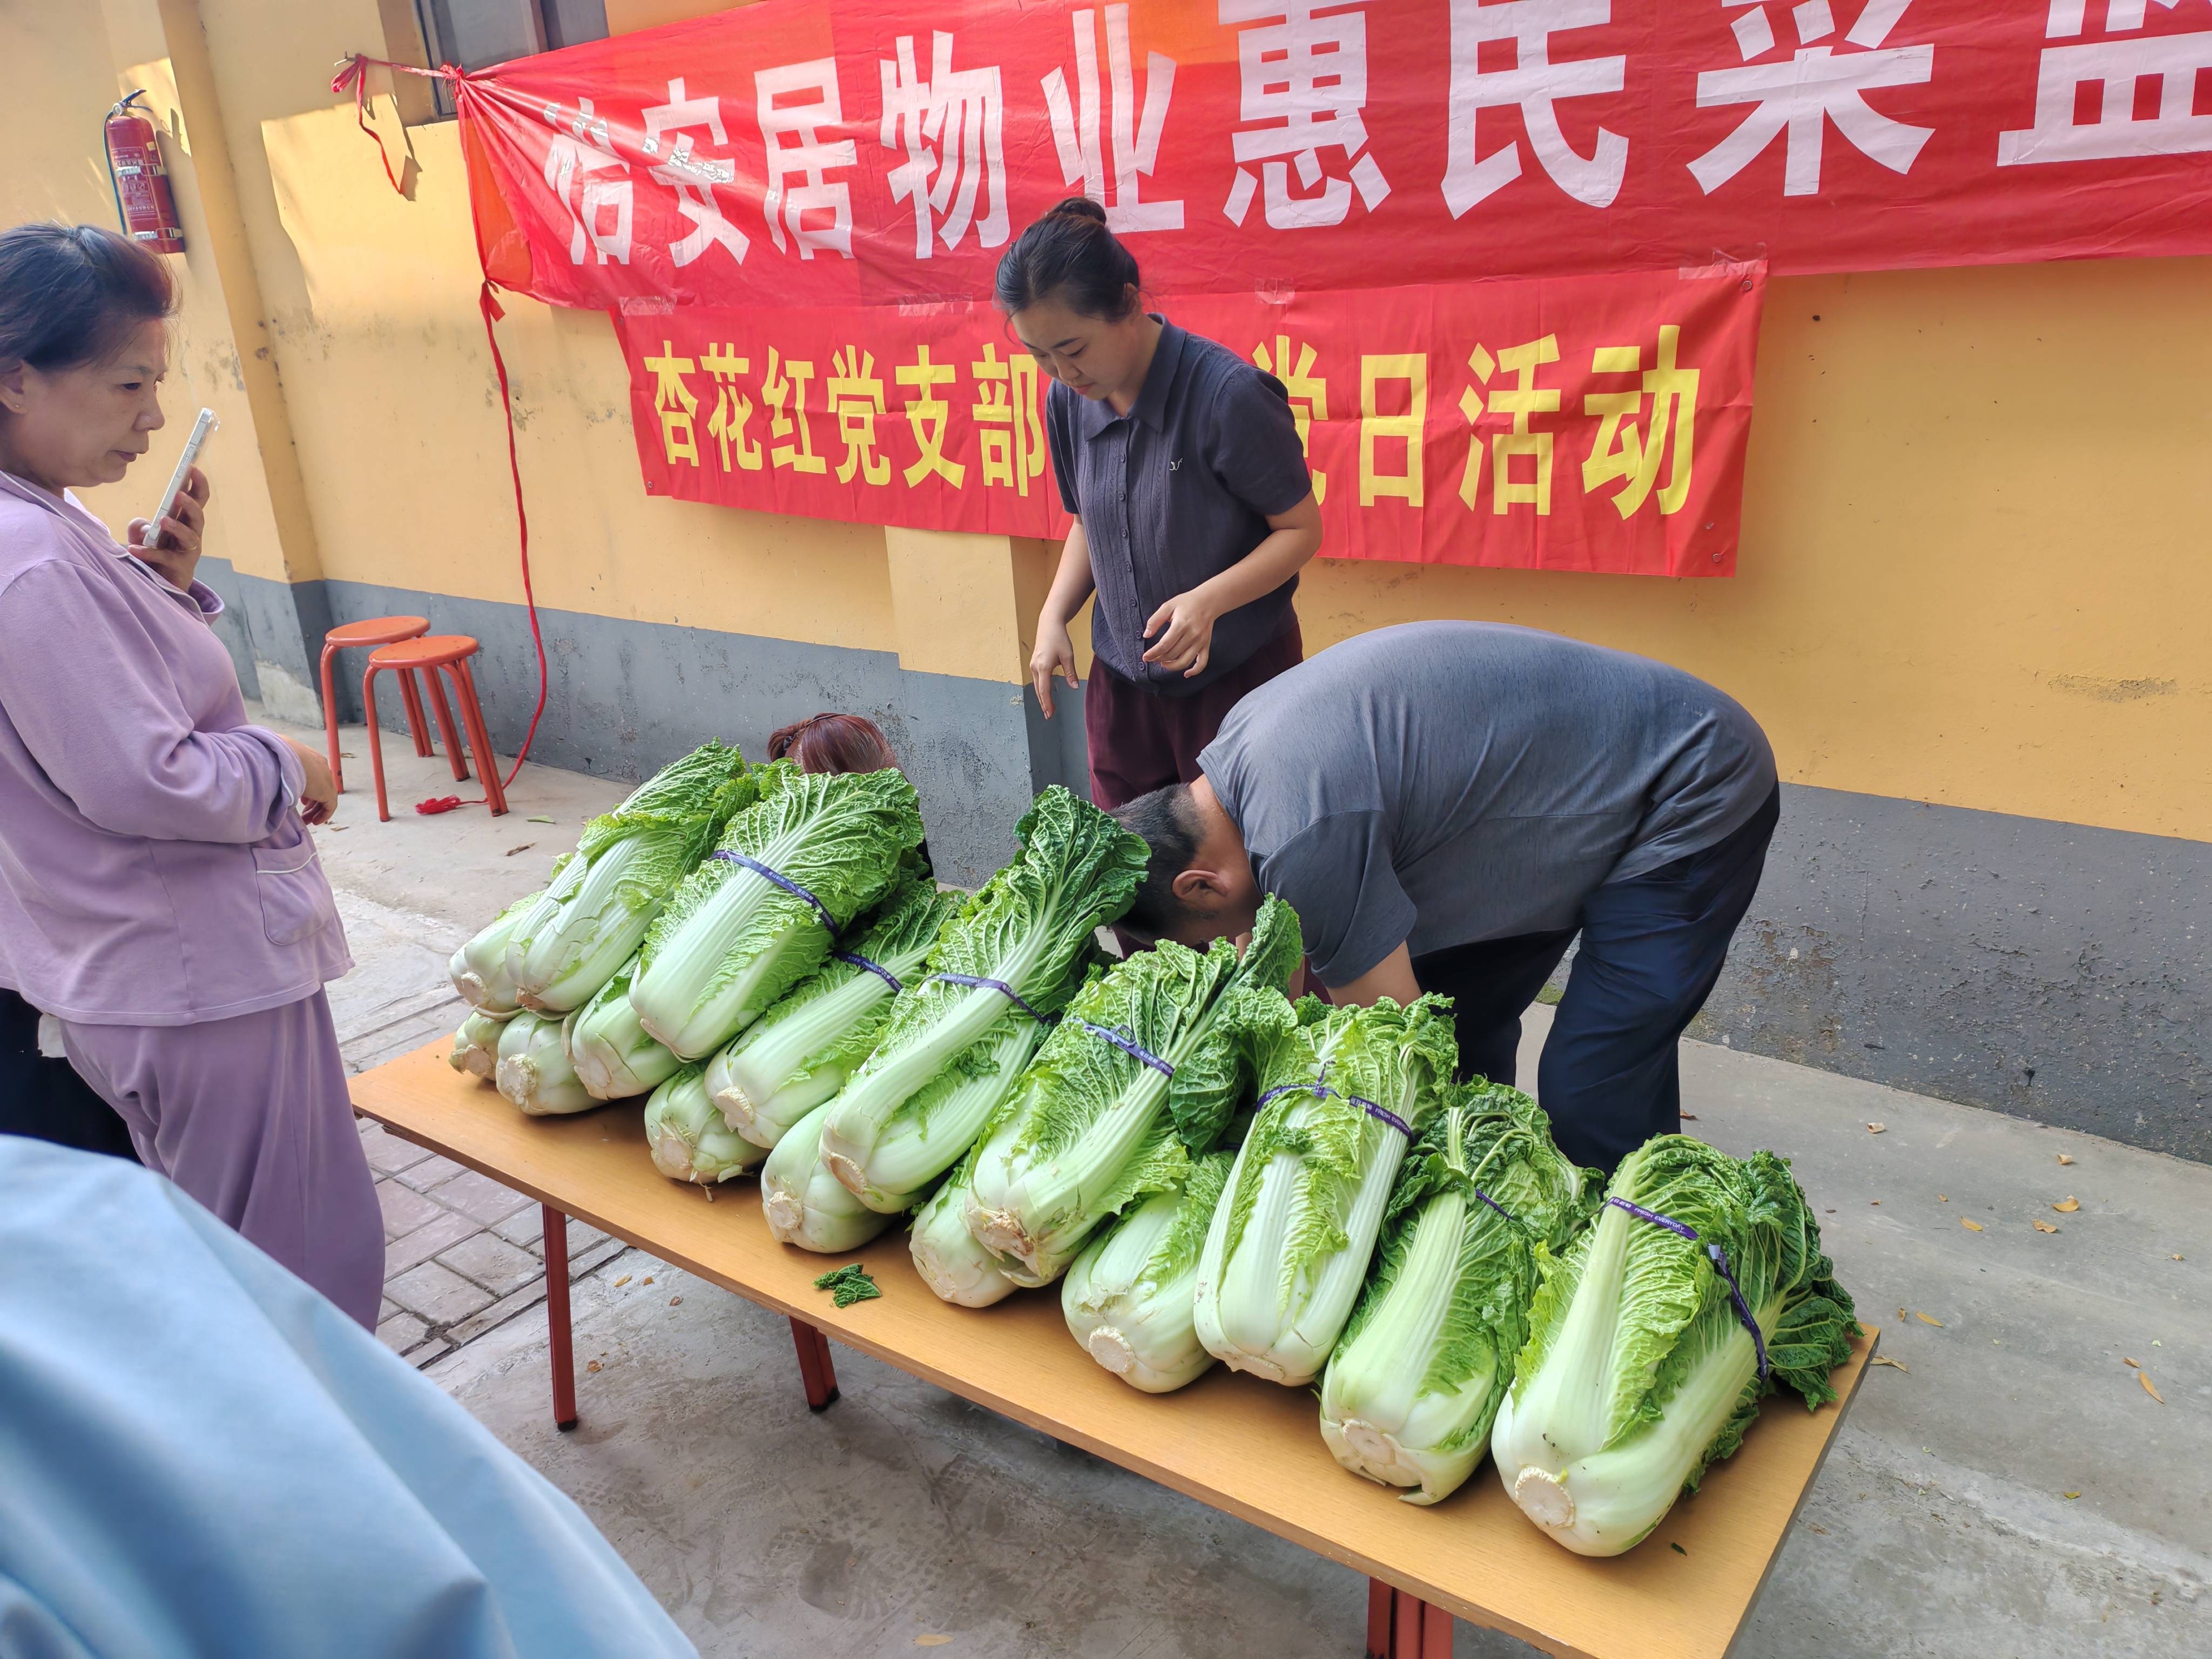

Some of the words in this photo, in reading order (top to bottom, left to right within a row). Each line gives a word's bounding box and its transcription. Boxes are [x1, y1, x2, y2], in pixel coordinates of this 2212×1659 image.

[644, 325, 1701, 520] 杏花红党支部党日活动
[1374, 1108, 1391, 1120] FRESH
[1610, 1197, 1632, 1209] 日新鲜
[1634, 1207, 1654, 1219] FRESH
[1654, 1215, 1685, 1231] EVERYDAY
